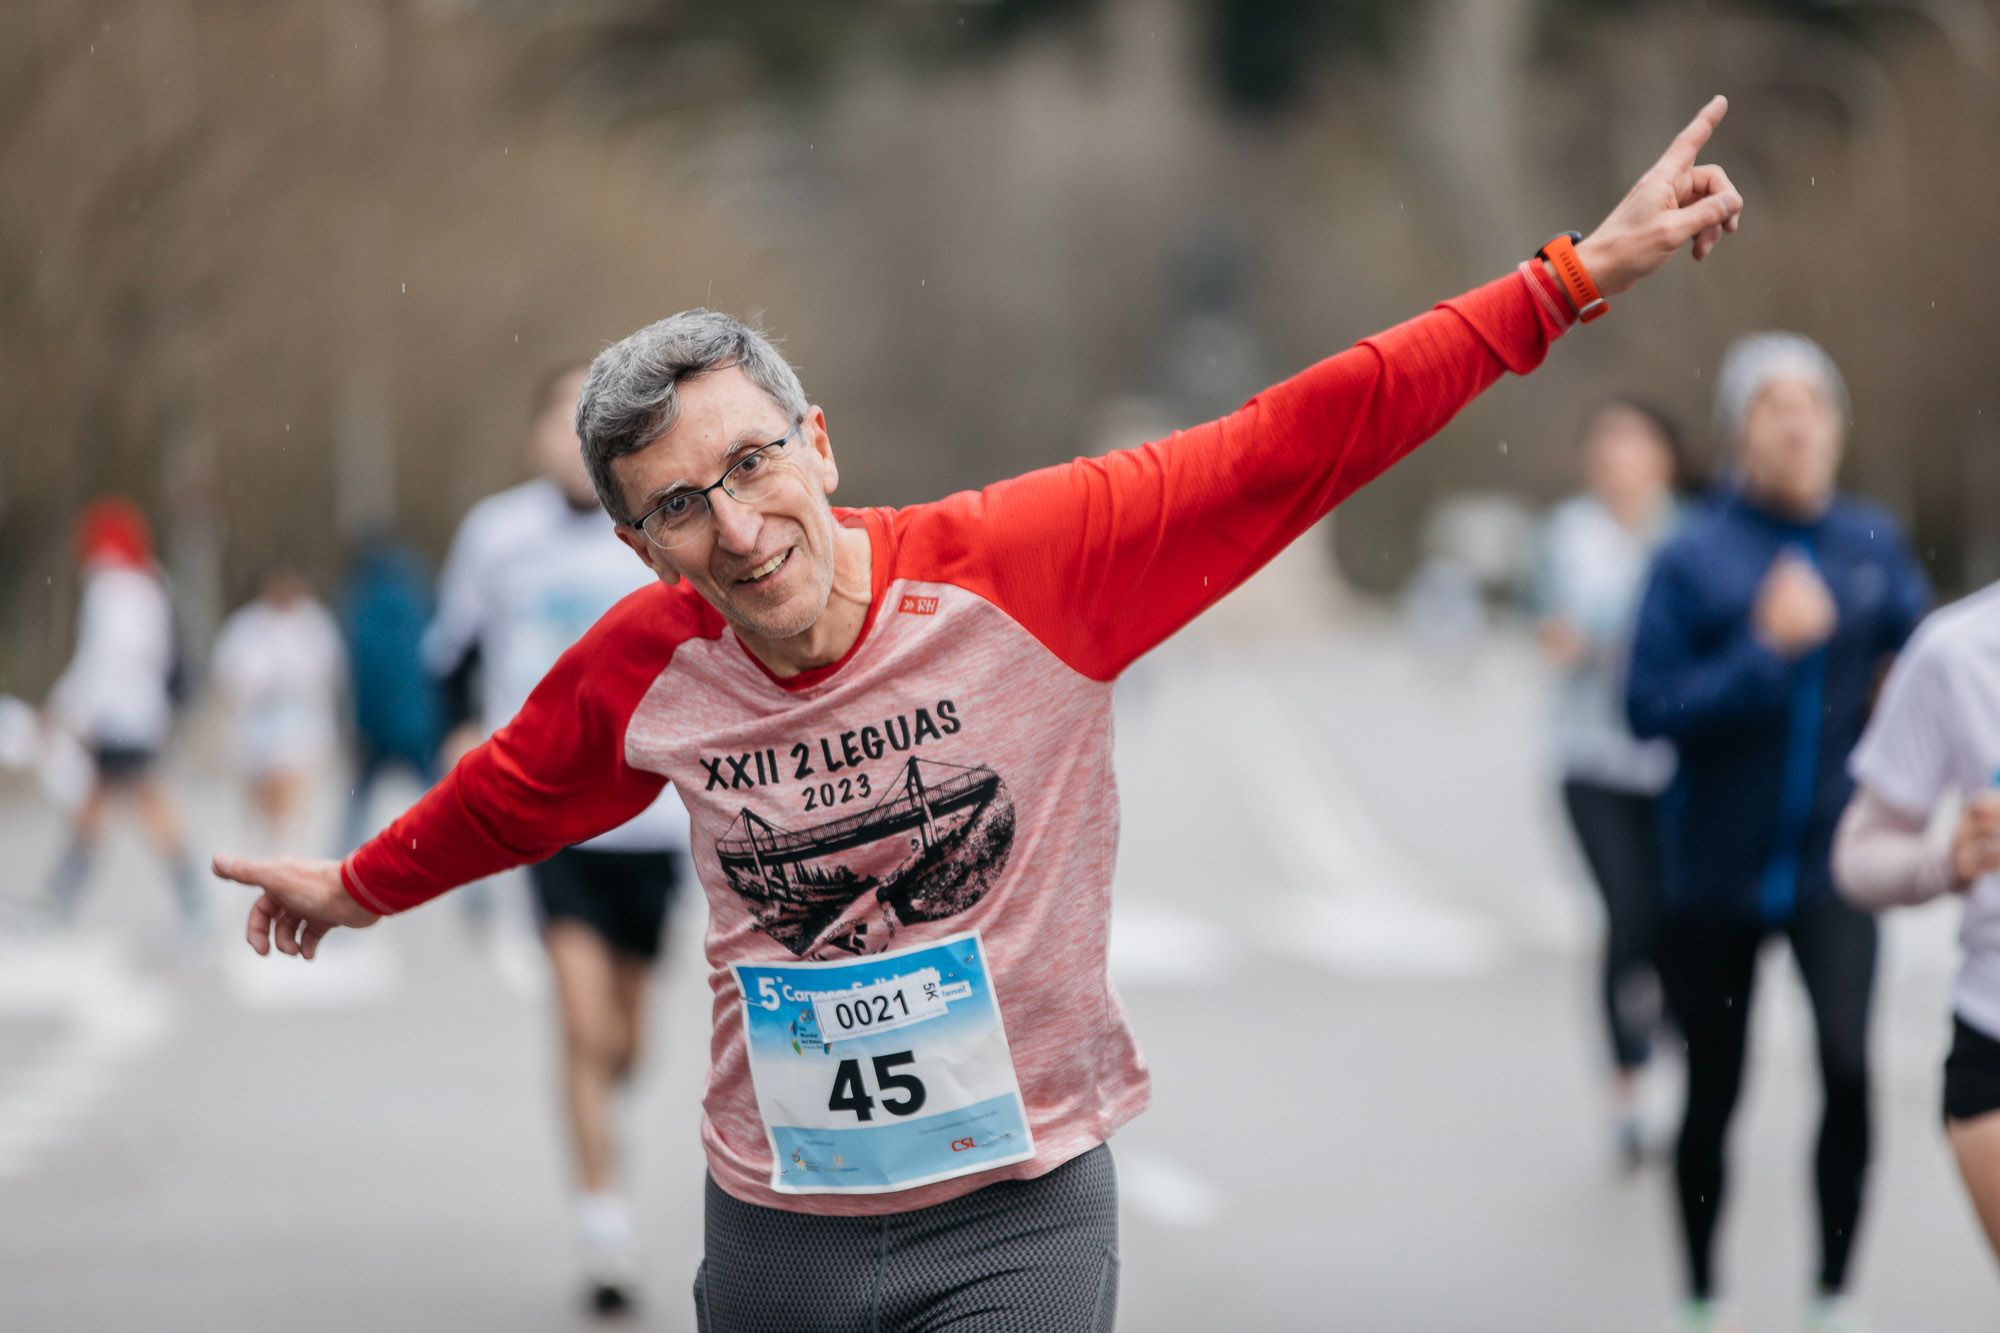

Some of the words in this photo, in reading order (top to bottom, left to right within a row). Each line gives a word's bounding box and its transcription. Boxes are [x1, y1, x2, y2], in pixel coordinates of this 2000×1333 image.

[699, 749, 780, 791] XXII
[790, 742, 815, 780] 2
[820, 699, 962, 772] LEGUAS
[802, 773, 873, 812] 2023
[835, 988, 910, 1030] 0021
[923, 982, 939, 1002] 5K
[828, 1050, 927, 1122] 45
[950, 1136, 977, 1152] CSL
